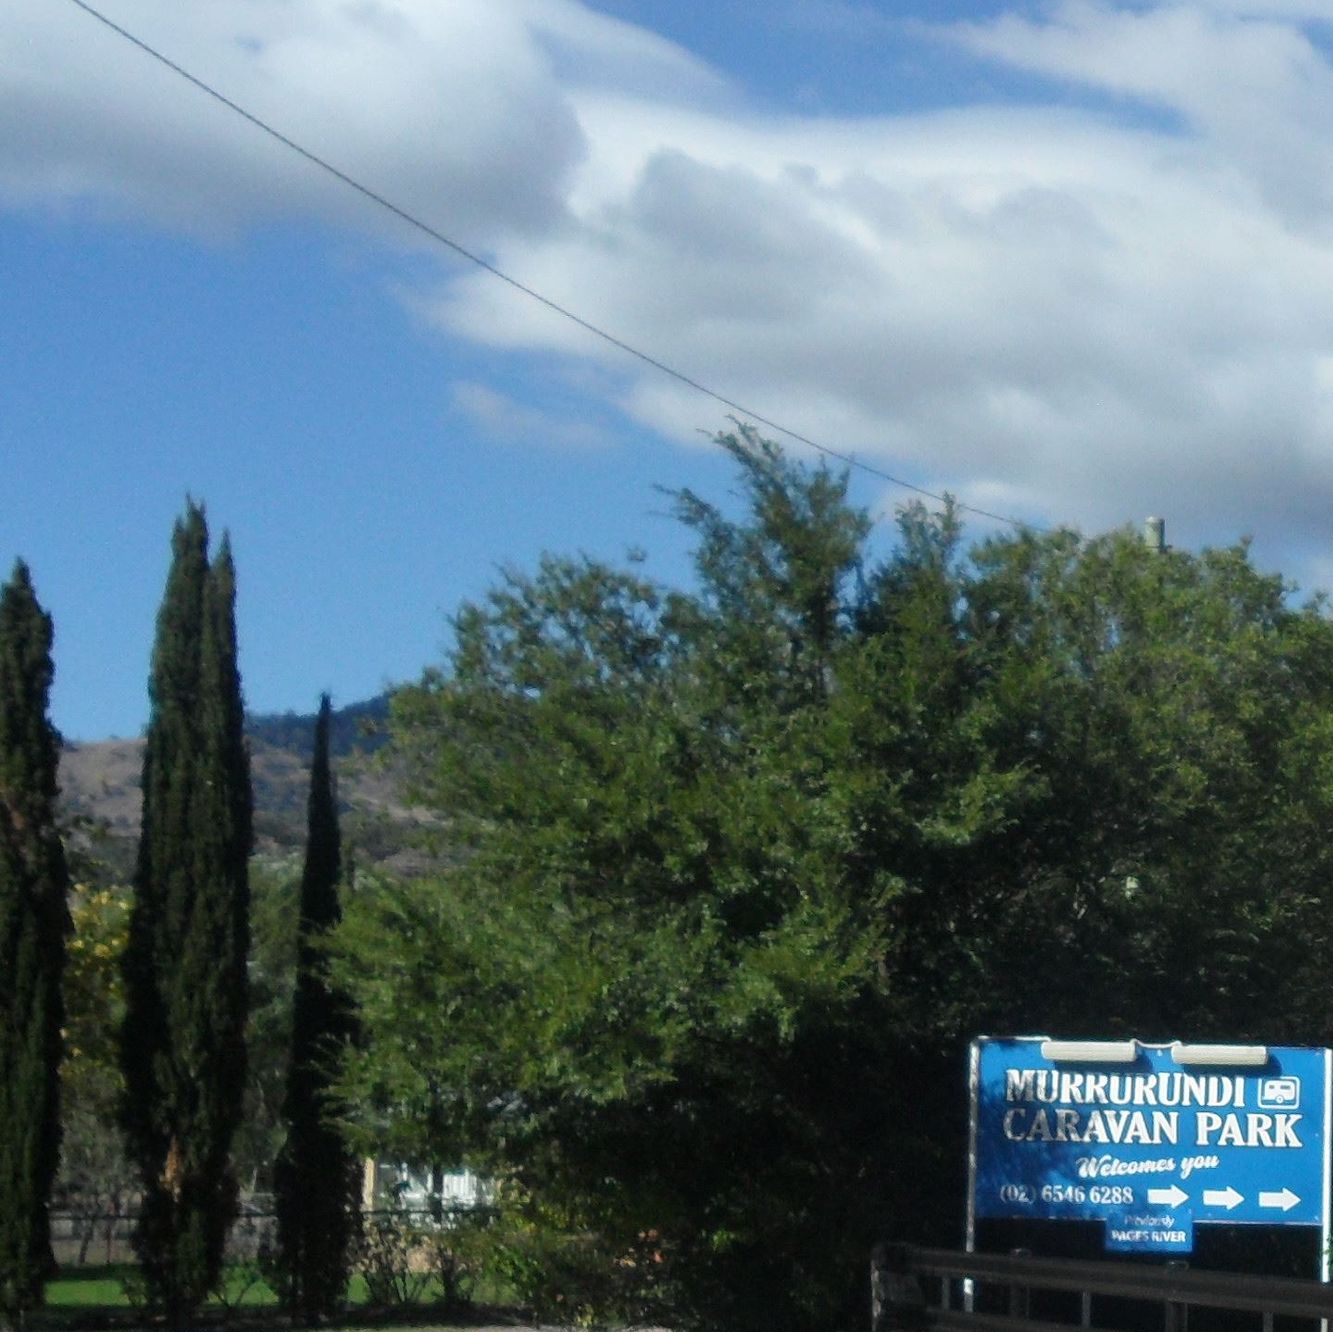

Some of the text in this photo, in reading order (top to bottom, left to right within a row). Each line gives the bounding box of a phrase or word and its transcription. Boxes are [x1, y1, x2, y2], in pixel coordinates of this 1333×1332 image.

[1006, 1069, 1245, 1107] MURRURUNDI
[1003, 1109, 1304, 1147] CARAVAN PARK
[1076, 1155, 1219, 1179] Welcomes you
[1000, 1184, 1134, 1204] (02) 6546 6288
[1151, 1231, 1186, 1242] RIVER
